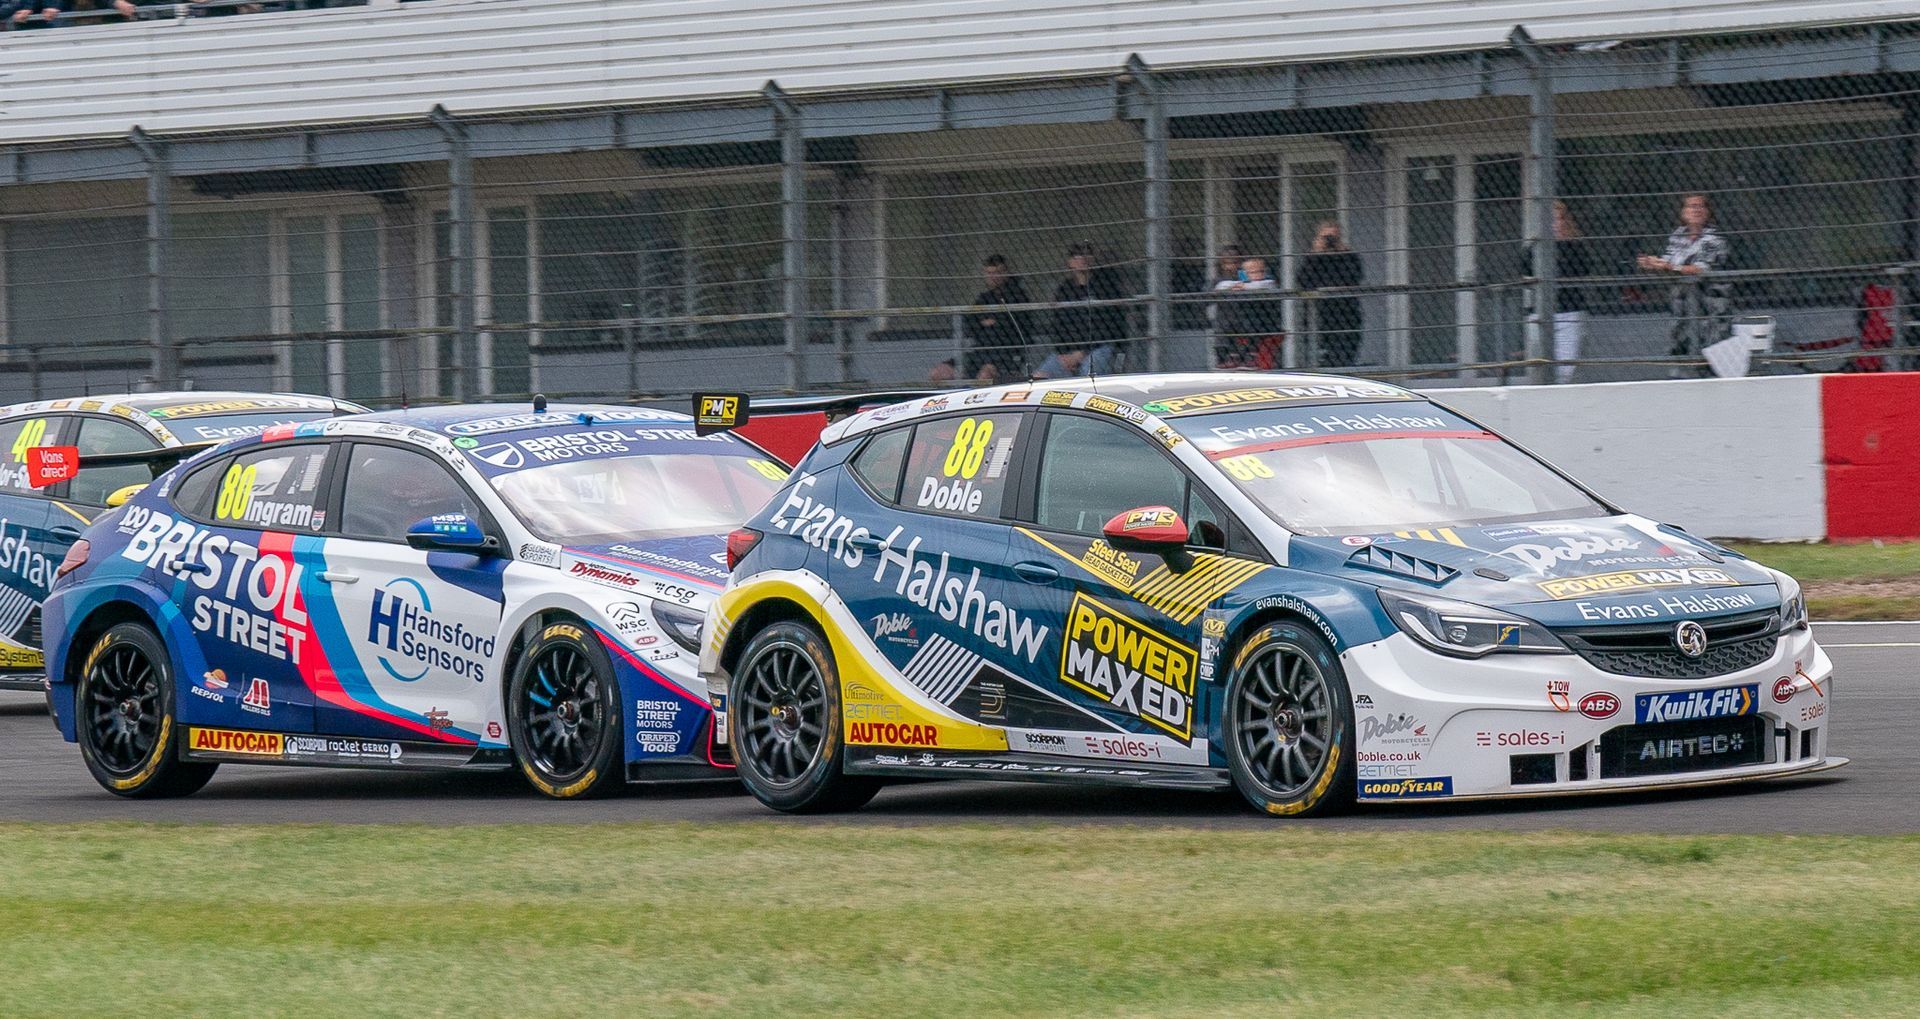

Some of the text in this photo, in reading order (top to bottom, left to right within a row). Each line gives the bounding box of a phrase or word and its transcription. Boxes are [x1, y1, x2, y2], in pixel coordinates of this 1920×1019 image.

[1169, 383, 1391, 411] POWER MAXED
[703, 399, 736, 416] PMR
[1087, 398, 1116, 411] POWER
[1115, 406, 1147, 420] MAXED
[1212, 413, 1445, 442] Evans Halshaw
[517, 429, 637, 452] BRISTOL
[943, 418, 994, 479] 88
[40, 450, 64, 464] Vans
[532, 442, 630, 461] MOTORS
[40, 465, 68, 479] direct
[1219, 455, 1275, 481] 88
[217, 464, 256, 520] 80
[917, 476, 982, 514] Doble
[244, 494, 312, 526] Ingram
[431, 514, 466, 522] MSP
[1128, 511, 1174, 522] PMR
[769, 471, 1049, 663] Evans Halshaw
[1084, 554, 1101, 570] HEAD
[1089, 539, 1141, 575] Steel Seal
[121, 511, 308, 627] BRISTOL
[570, 560, 640, 586] Dynamics
[1551, 568, 1731, 597] POWER MAXED
[1575, 592, 1756, 620] Evans Halshaw
[191, 596, 306, 665] STREET
[402, 603, 496, 658] Hansford
[616, 619, 648, 630] WSC
[1255, 594, 1338, 647] evanshalshaw.com
[543, 624, 584, 641] EAGLE
[401, 628, 485, 683] Sensors
[1073, 603, 1188, 692] POWER
[1067, 641, 1187, 726] MAXED
[1554, 681, 1570, 691] TOW
[1777, 684, 1796, 696] ABS
[191, 685, 224, 703] REPSOL
[1355, 695, 1373, 704] JFA
[637, 700, 681, 711] BRISTOL
[637, 710, 677, 721] STREET
[1585, 699, 1616, 712] ABS
[637, 720, 673, 729] MOTORS
[850, 722, 938, 746] AUTOCAR
[195, 729, 278, 753] AUTOCAR
[328, 740, 360, 753] rocket
[640, 732, 676, 742] DRAPER
[1026, 732, 1065, 745] SCORPION
[1104, 736, 1161, 758] sales-i
[1498, 729, 1564, 746] sales-i
[361, 743, 389, 753] GERKO
[643, 742, 676, 753] Tools
[1358, 751, 1421, 762] Doble.co.uk
[1640, 736, 1728, 760] AIRTEC
[1364, 780, 1444, 796] GOODYEAR
